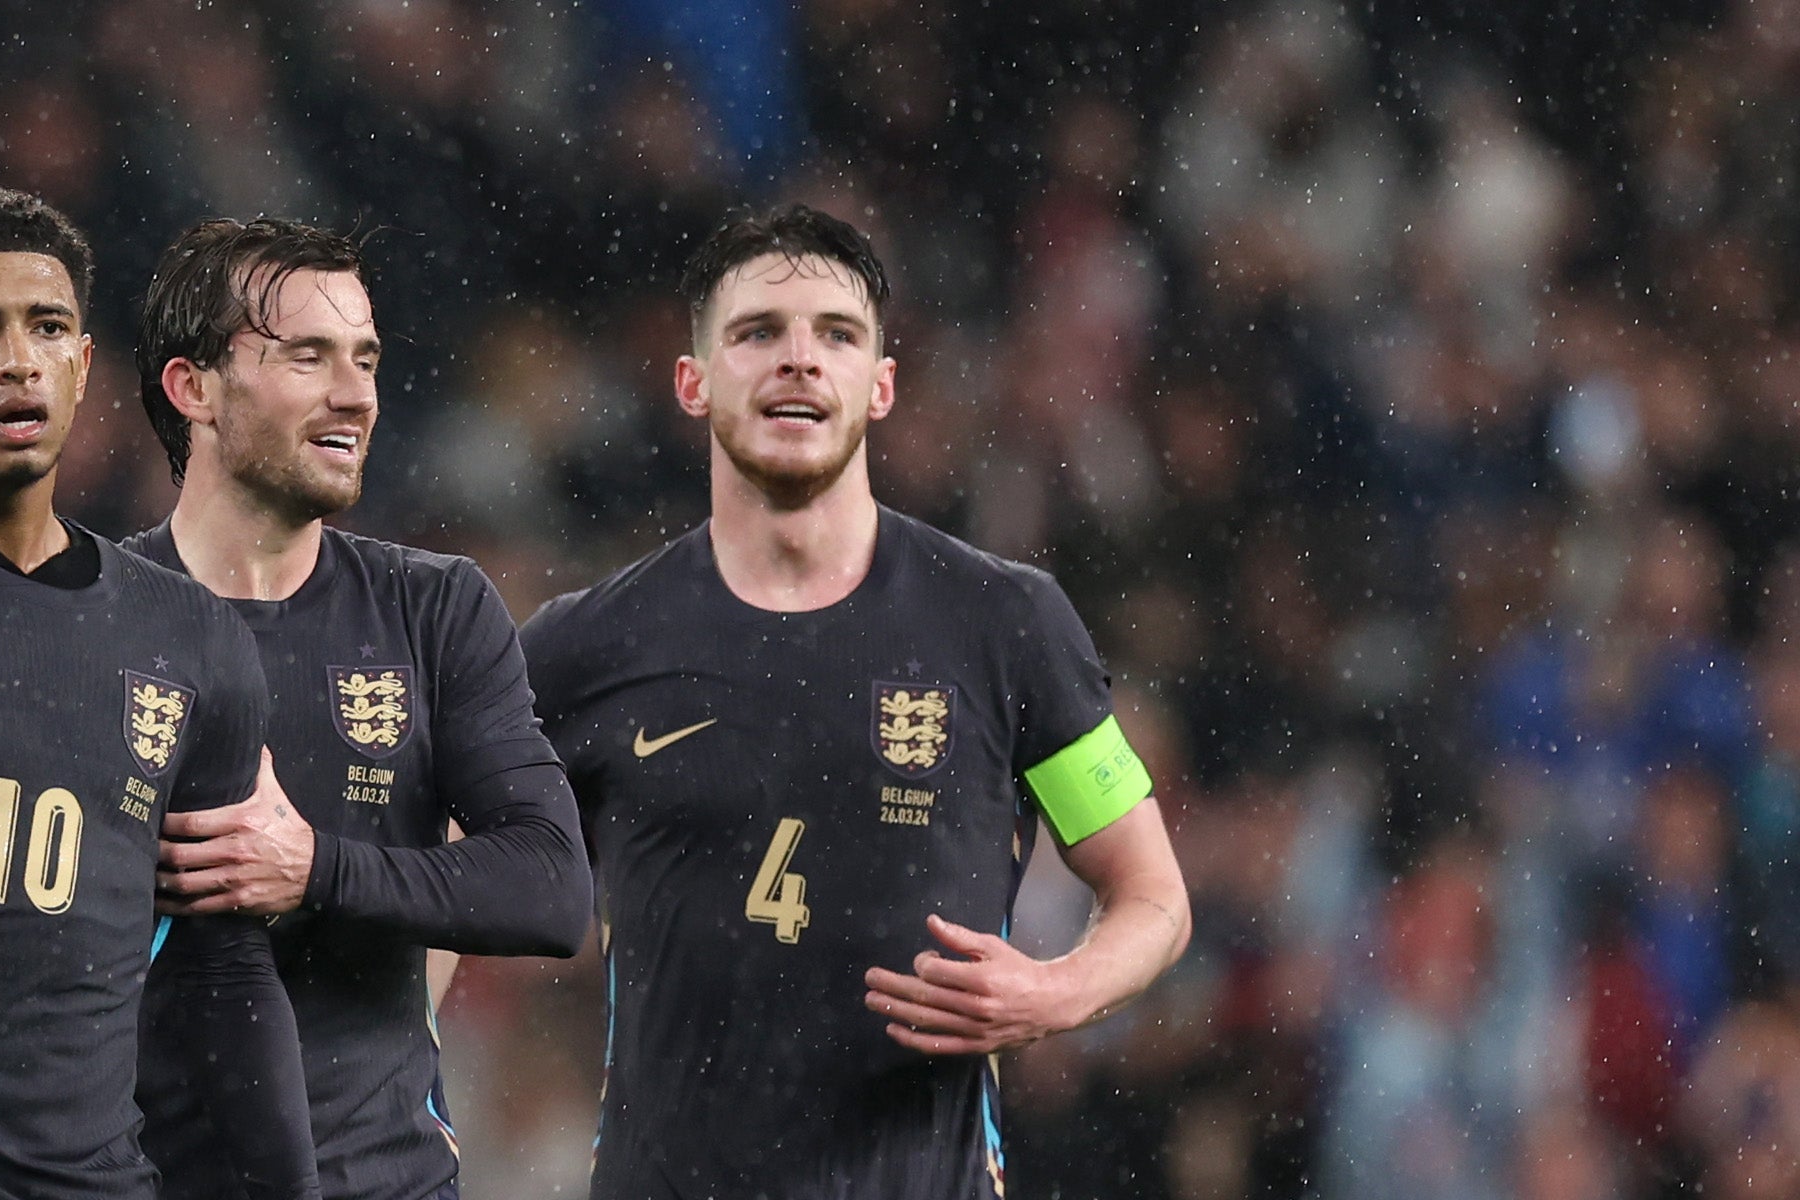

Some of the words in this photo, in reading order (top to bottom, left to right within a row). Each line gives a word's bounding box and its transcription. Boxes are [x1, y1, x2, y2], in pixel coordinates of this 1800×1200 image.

[347, 765, 395, 785] BELGIUM
[125, 776, 158, 805] BELGIUM
[346, 785, 390, 805] 26.03.24
[881, 786, 935, 807] BELGIUM
[880, 806, 929, 826] 26.03.24
[745, 817, 810, 944] 4
